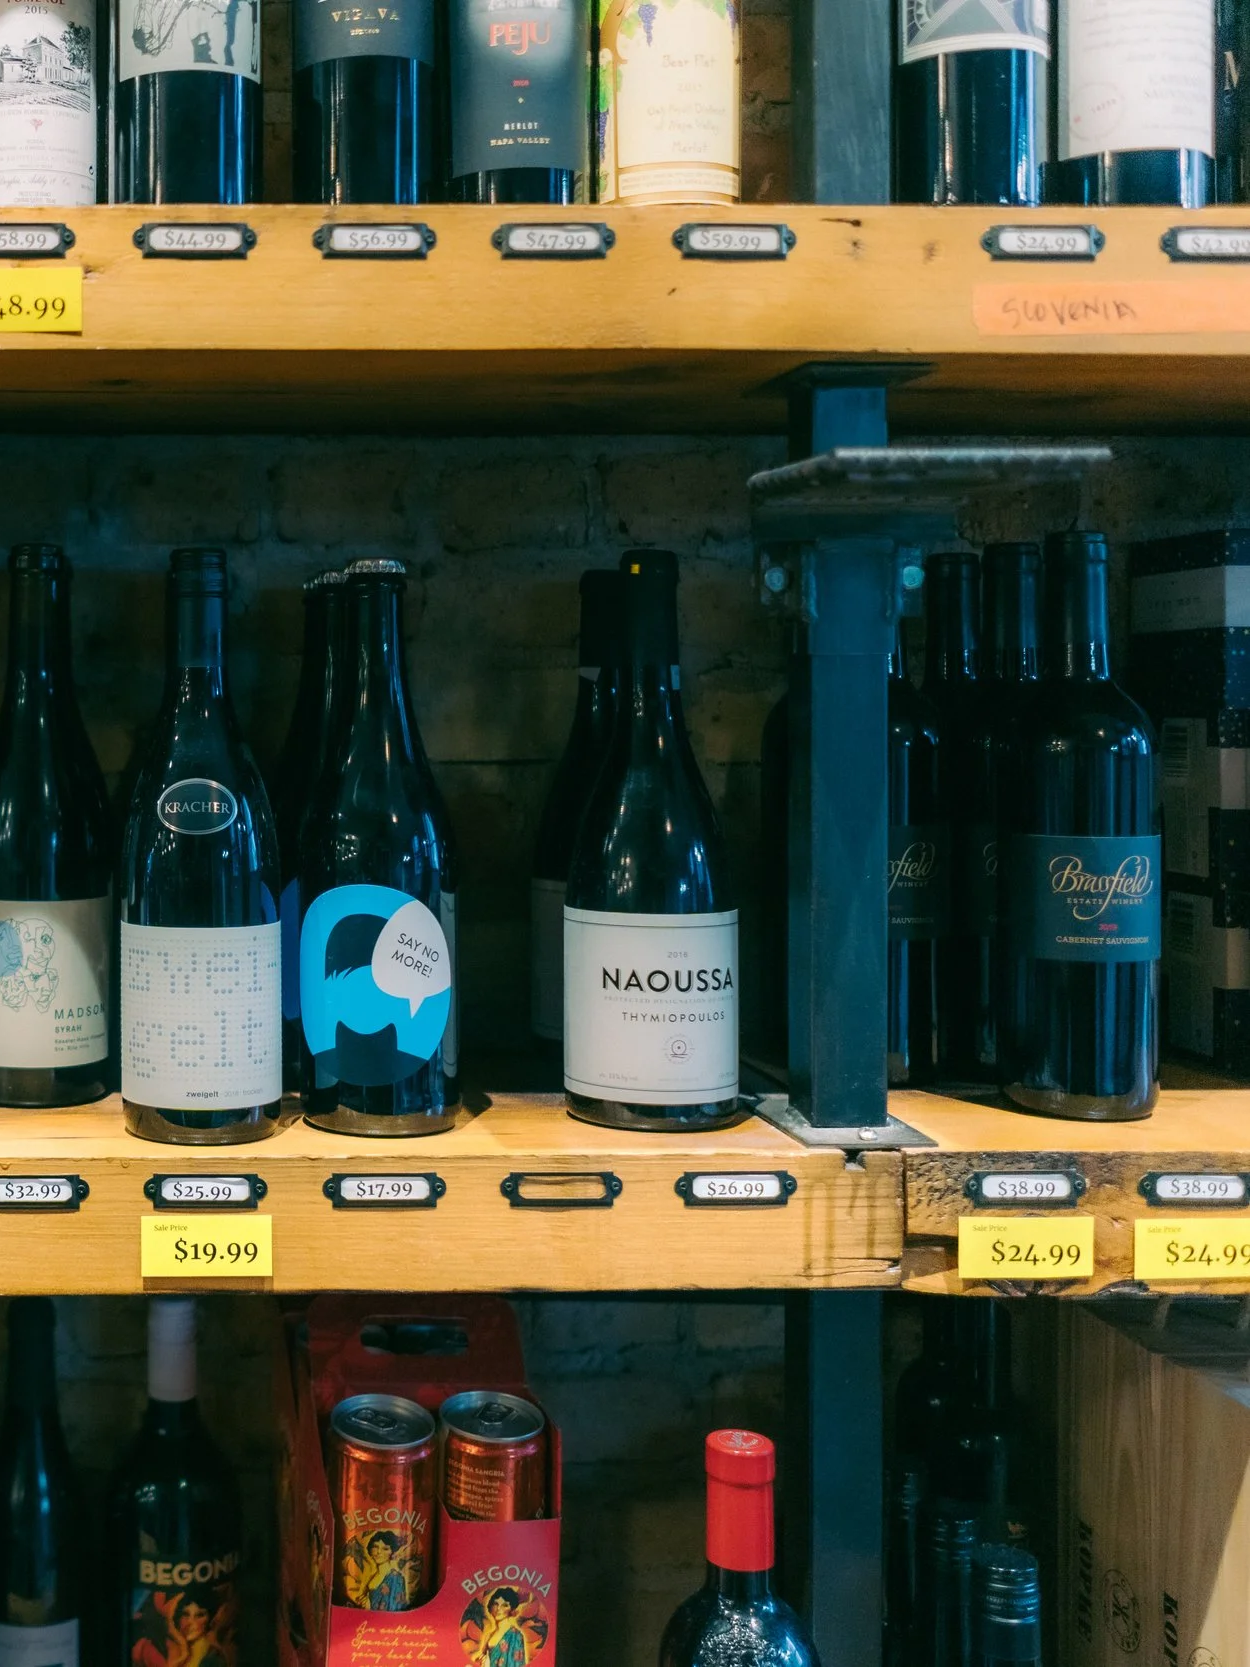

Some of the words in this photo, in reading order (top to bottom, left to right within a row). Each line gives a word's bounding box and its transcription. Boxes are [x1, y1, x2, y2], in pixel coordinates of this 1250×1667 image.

[25, 6, 48, 15] 2015
[489, 20, 550, 55] PEJU
[503, 122, 538, 131] MERLOT
[490, 138, 514, 147] NAPA
[517, 137, 550, 145] VALLEY
[164, 229, 227, 249] $44.99
[349, 231, 408, 249] $56.99
[526, 230, 586, 249] $47.99
[700, 229, 761, 250] $59.99
[1016, 232, 1077, 251] $24.99
[1001, 295, 1138, 330] SLOVENIA
[164, 801, 230, 814] KRACHER
[1049, 855, 1153, 920] Brassfield
[1066, 897, 1104, 905] ESTATE
[1111, 897, 1143, 905] WINERY
[397, 932, 423, 953] SAY
[421, 945, 440, 963] NO
[1055, 934, 1104, 944] CABERNET
[1105, 936, 1150, 945] SAUVIGNON
[391, 950, 434, 979] MORE!
[602, 966, 734, 993] NAOUSSA
[54, 1003, 105, 1020] MADSON
[621, 1010, 725, 1023] THYMIOPOULOS
[54, 1024, 82, 1034] SYRAH
[186, 1090, 219, 1099] zweigelt
[5, 1181, 61, 1200] $32.99
[173, 1181, 232, 1201] $25.99
[356, 1180, 413, 1198] $17.99
[707, 1180, 765, 1198] $26.99
[998, 1180, 1056, 1198] $38.99
[1170, 1178, 1229, 1197] $38.99
[972, 1224, 987, 1232] Sale
[988, 1224, 1007, 1232] Price
[174, 1237, 258, 1263] $19.99
[991, 1239, 1081, 1266] $24.99
[1166, 1240, 1250, 1266] $24.99
[342, 1507, 427, 1534] BEGONIA
[461, 1564, 552, 1597] BEGONIA
[356, 1620, 376, 1635] An
[379, 1624, 437, 1635] authentic
[351, 1633, 399, 1649] Spanish
